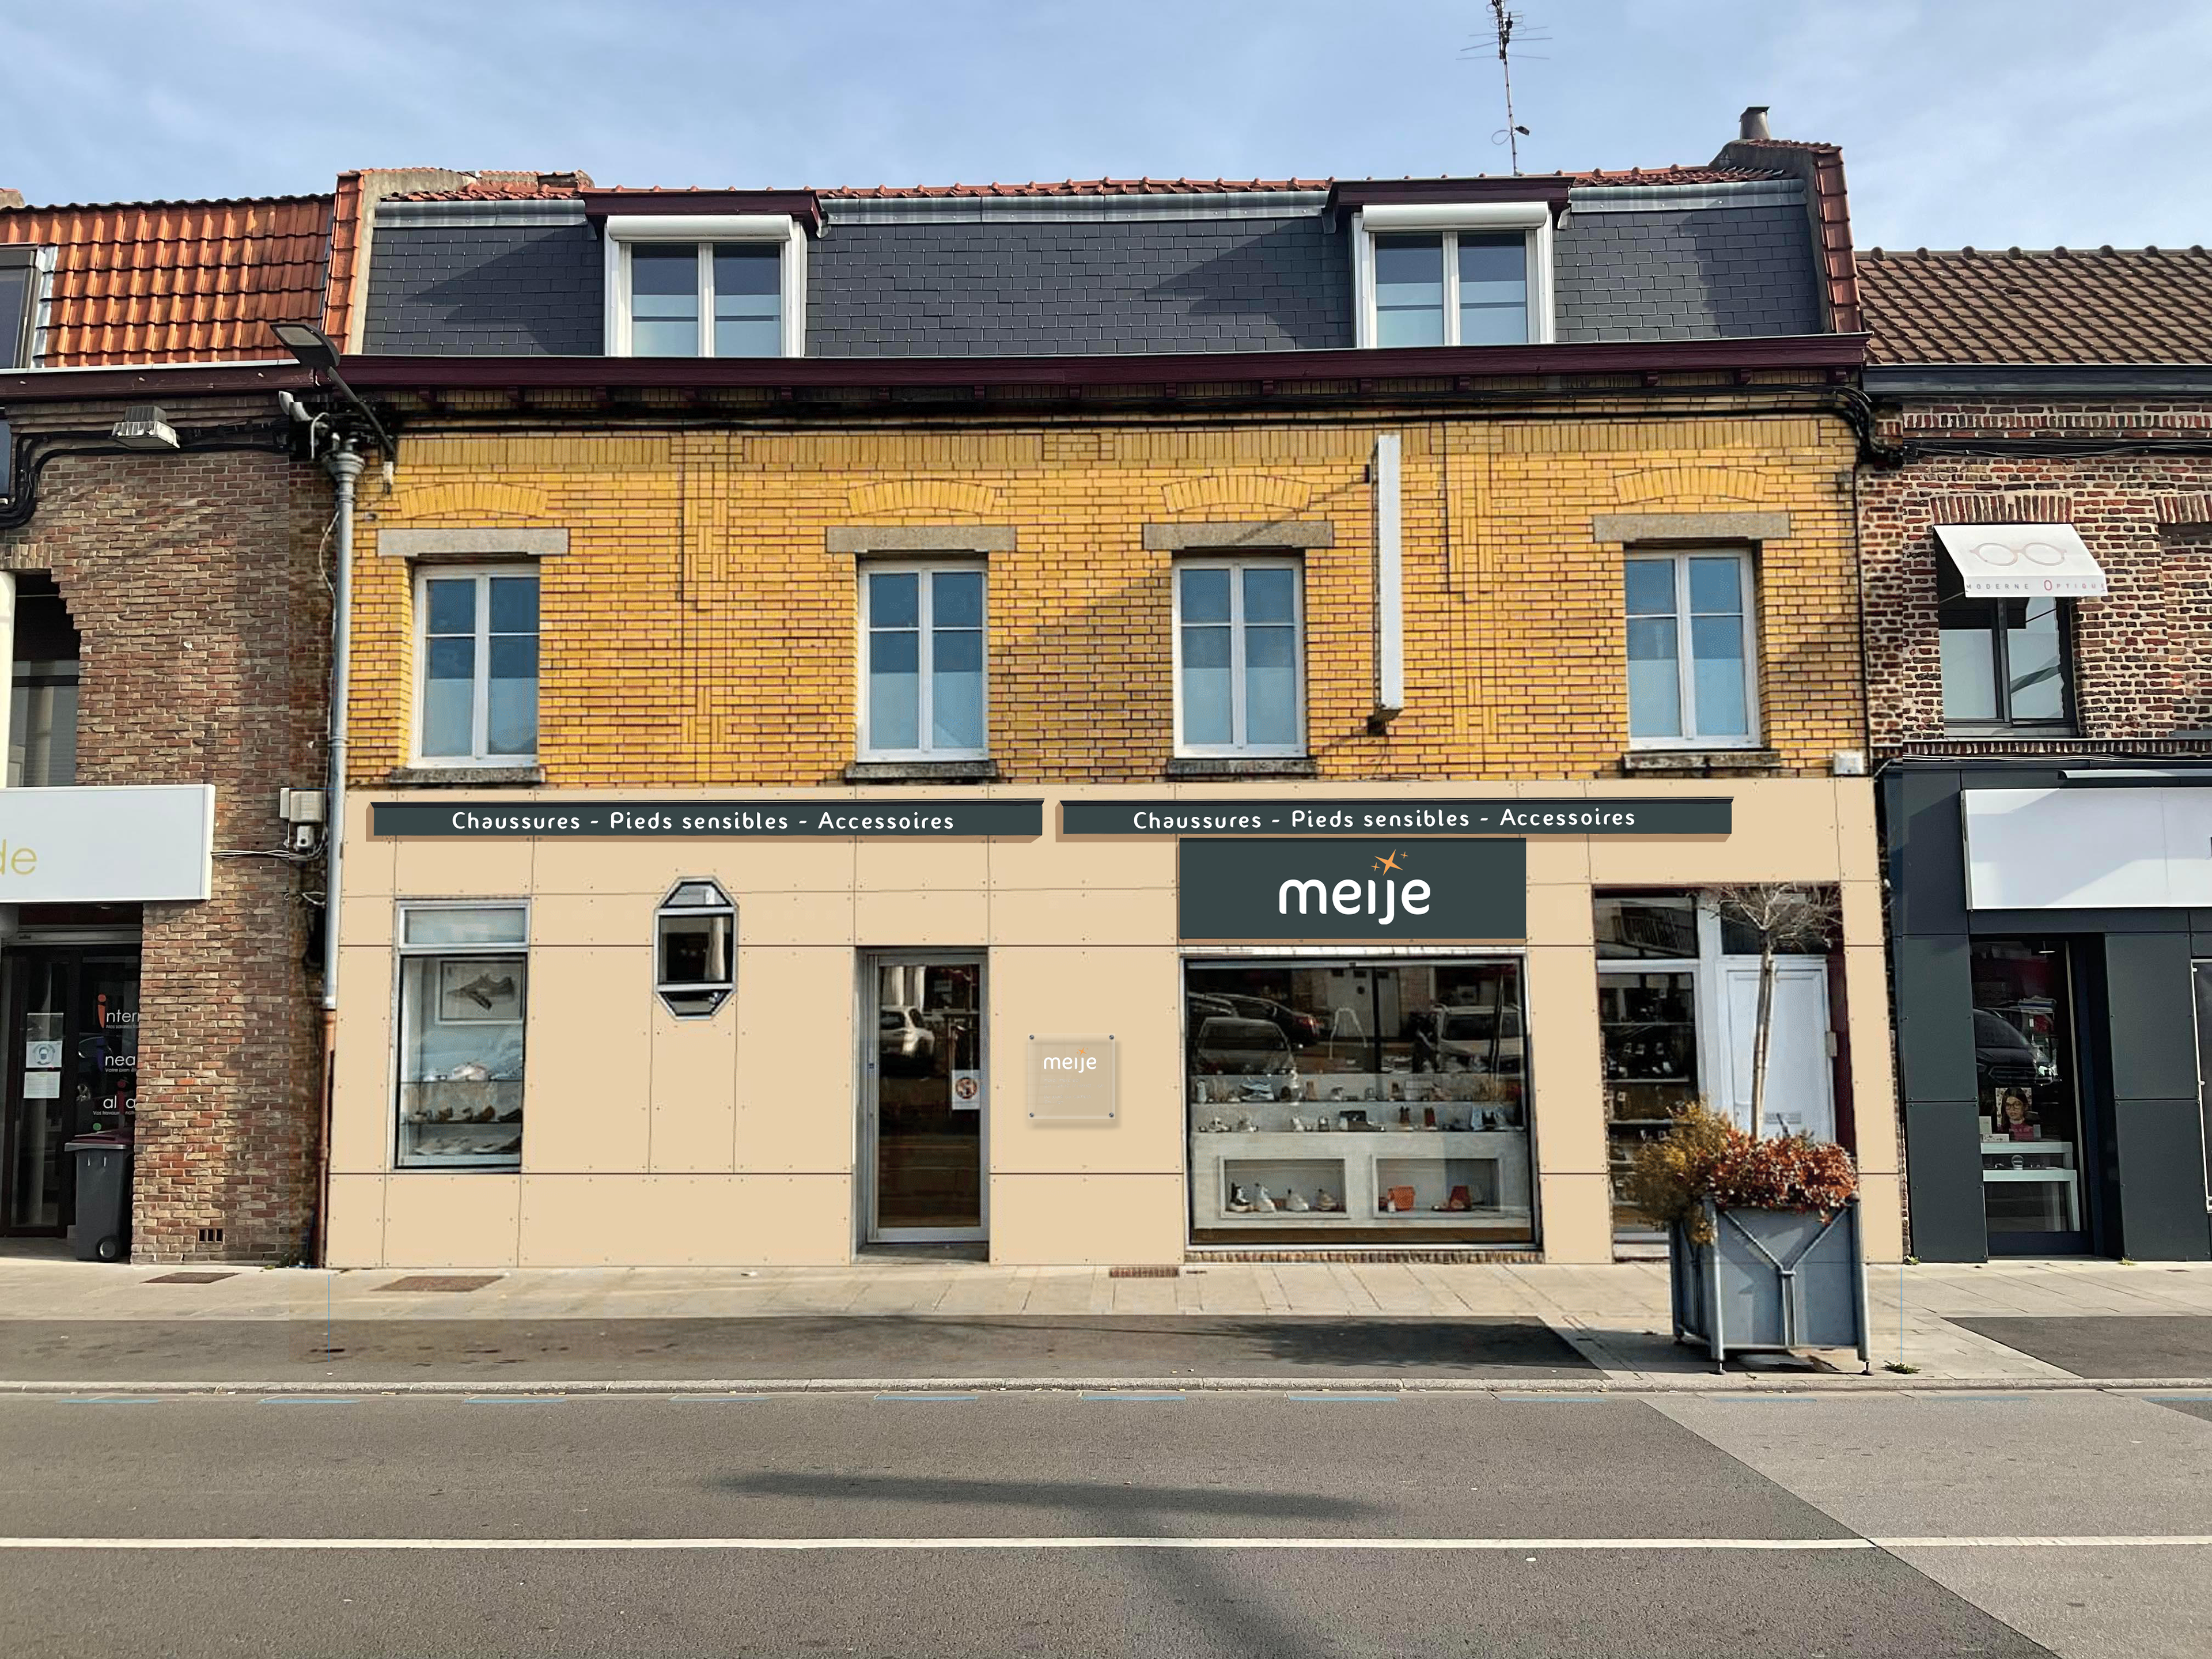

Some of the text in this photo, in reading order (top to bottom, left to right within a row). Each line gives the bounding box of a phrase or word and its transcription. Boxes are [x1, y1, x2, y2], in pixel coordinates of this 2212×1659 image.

[452, 812, 580, 830] Chaussures
[611, 812, 672, 830] Pieds
[682, 812, 788, 830] sensibles
[817, 812, 953, 830] Accessoires
[1134, 812, 1262, 830] Chaussures
[1292, 810, 1354, 828] Pieds
[1363, 809, 1469, 827] sensibles
[1499, 808, 1635, 826] Accessoires
[1279, 878, 1431, 925] meije
[1043, 1056, 1097, 1073] meije
